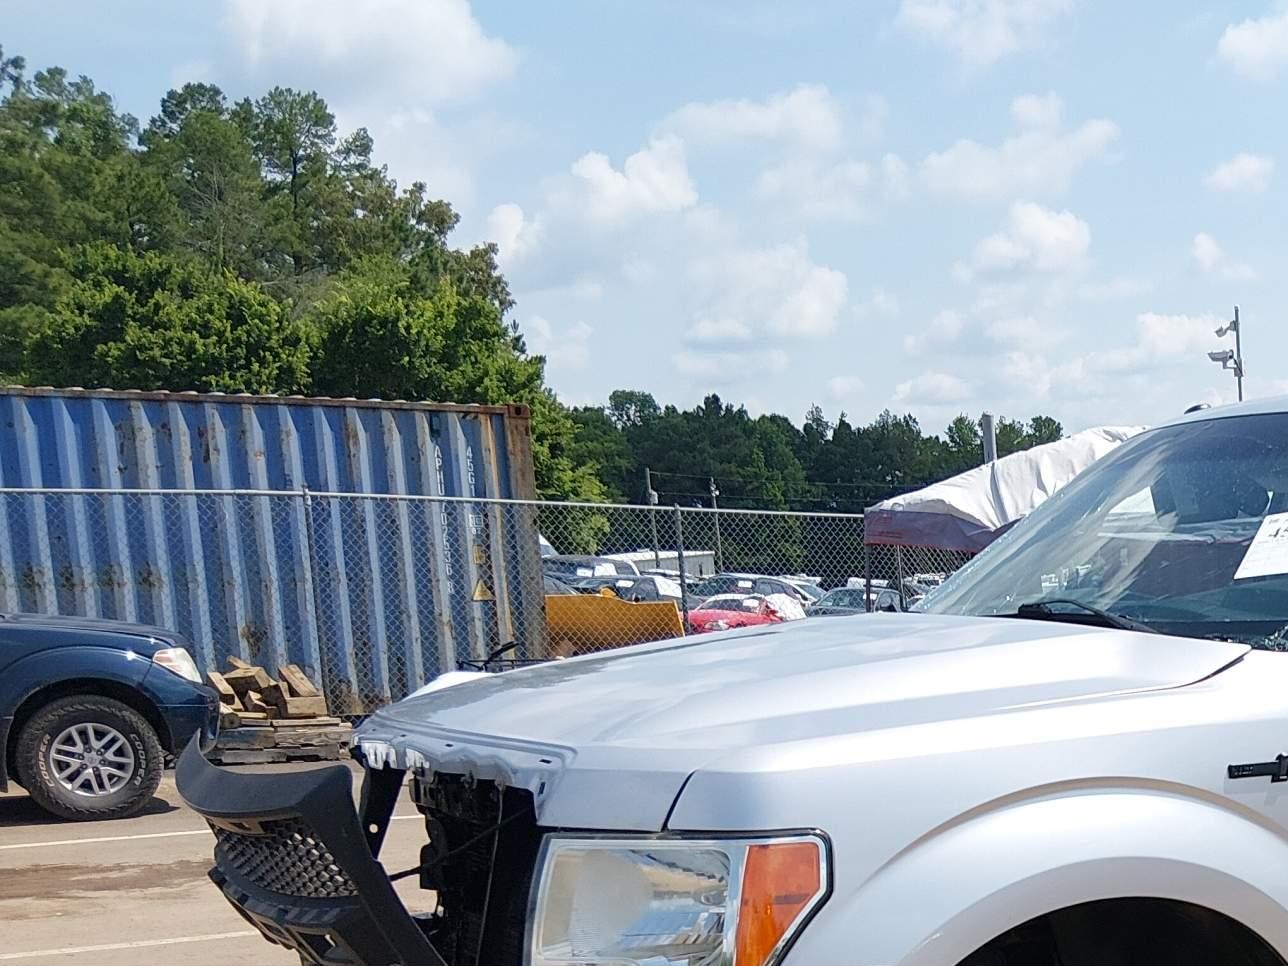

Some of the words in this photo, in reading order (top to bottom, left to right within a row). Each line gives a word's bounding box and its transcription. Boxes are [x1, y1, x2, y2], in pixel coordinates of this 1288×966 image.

[434, 445, 445, 496] APHU
[466, 446, 476, 497] 45G1
[38, 733, 55, 788] COOPER
[129, 733, 147, 786] COOPER
